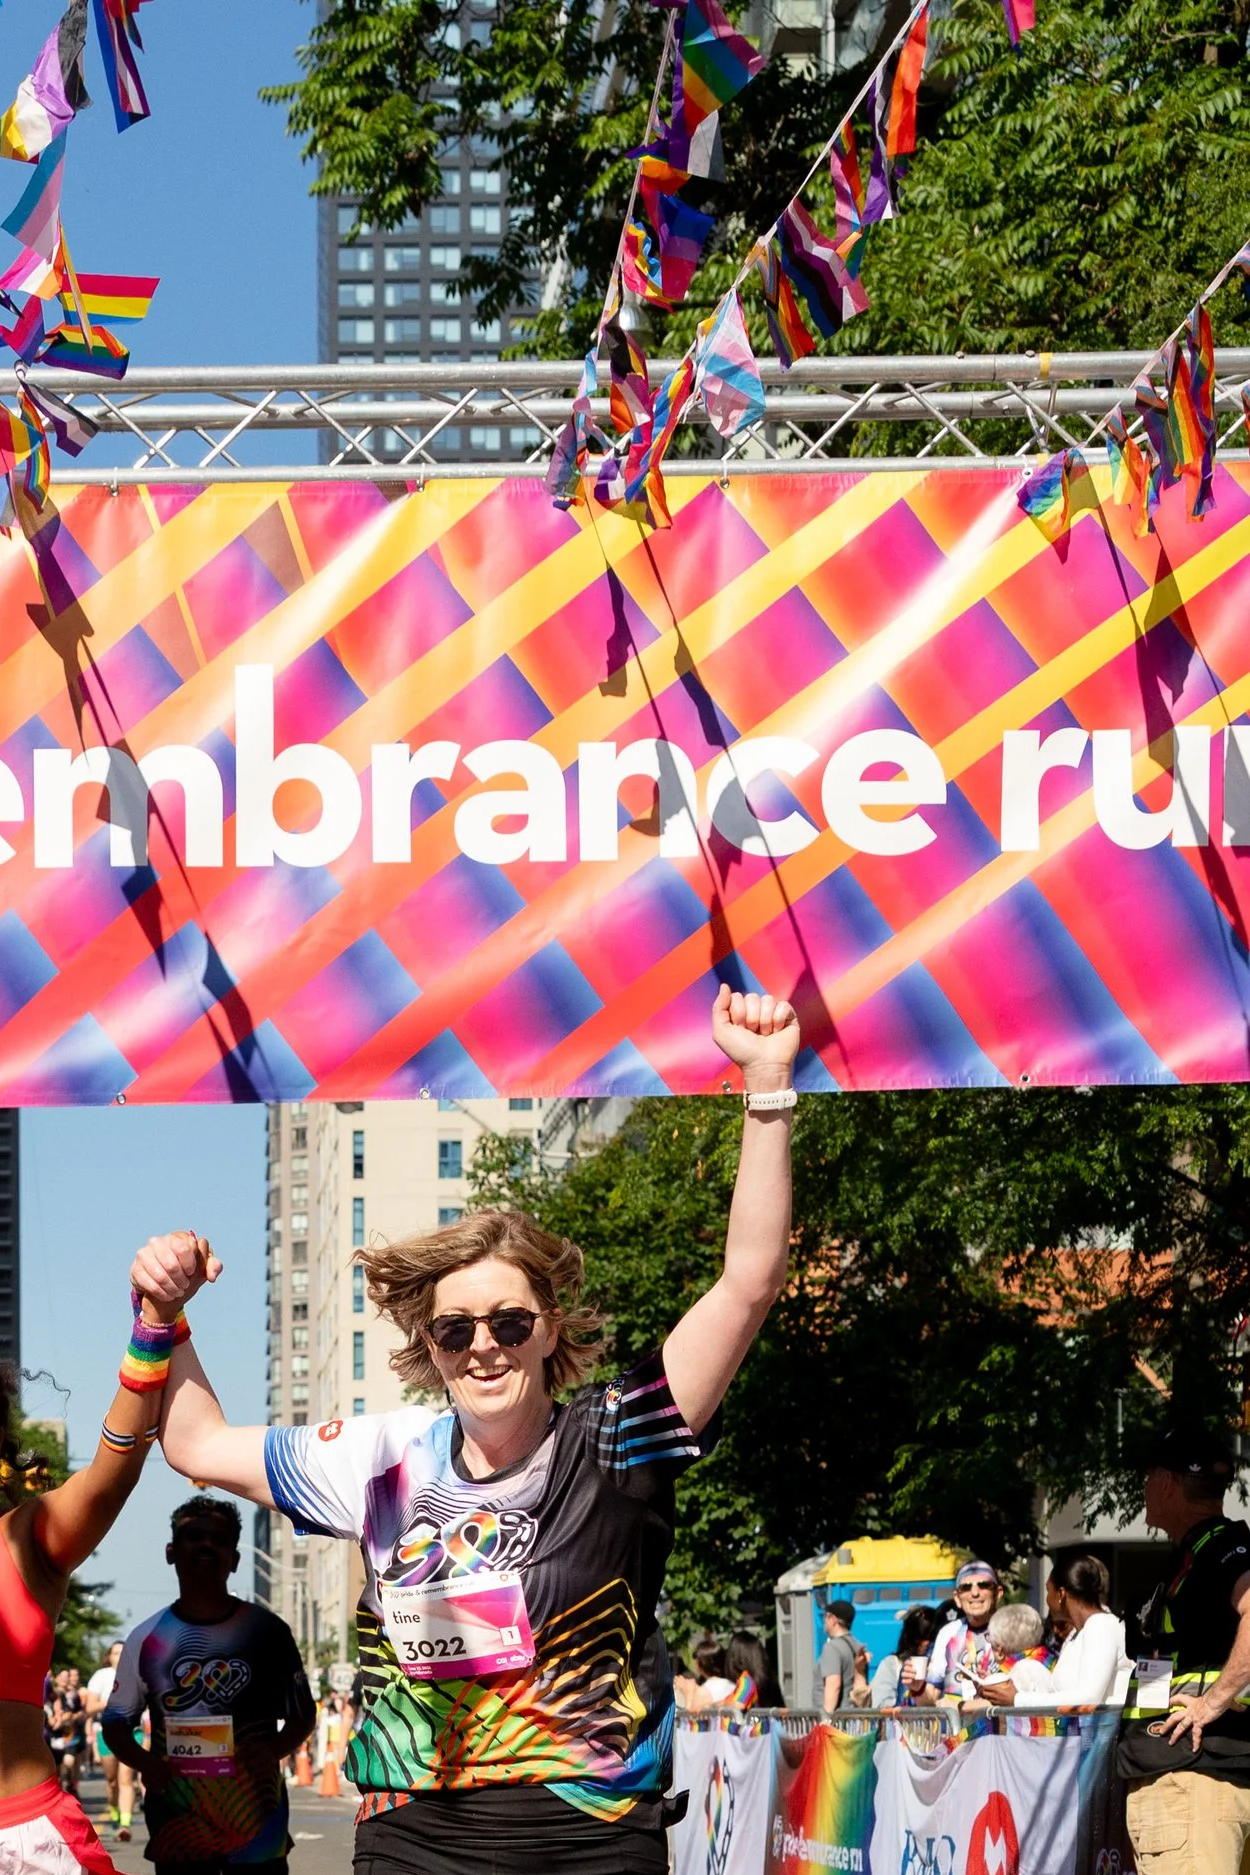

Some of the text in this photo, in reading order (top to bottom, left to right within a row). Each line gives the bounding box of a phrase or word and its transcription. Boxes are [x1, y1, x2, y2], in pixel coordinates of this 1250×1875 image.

[1001, 723, 1250, 854] ru
[393, 1610, 421, 1624] tine
[507, 1630, 514, 1640] 1
[403, 1636, 467, 1662] 3022
[172, 1744, 202, 1756] 4042
